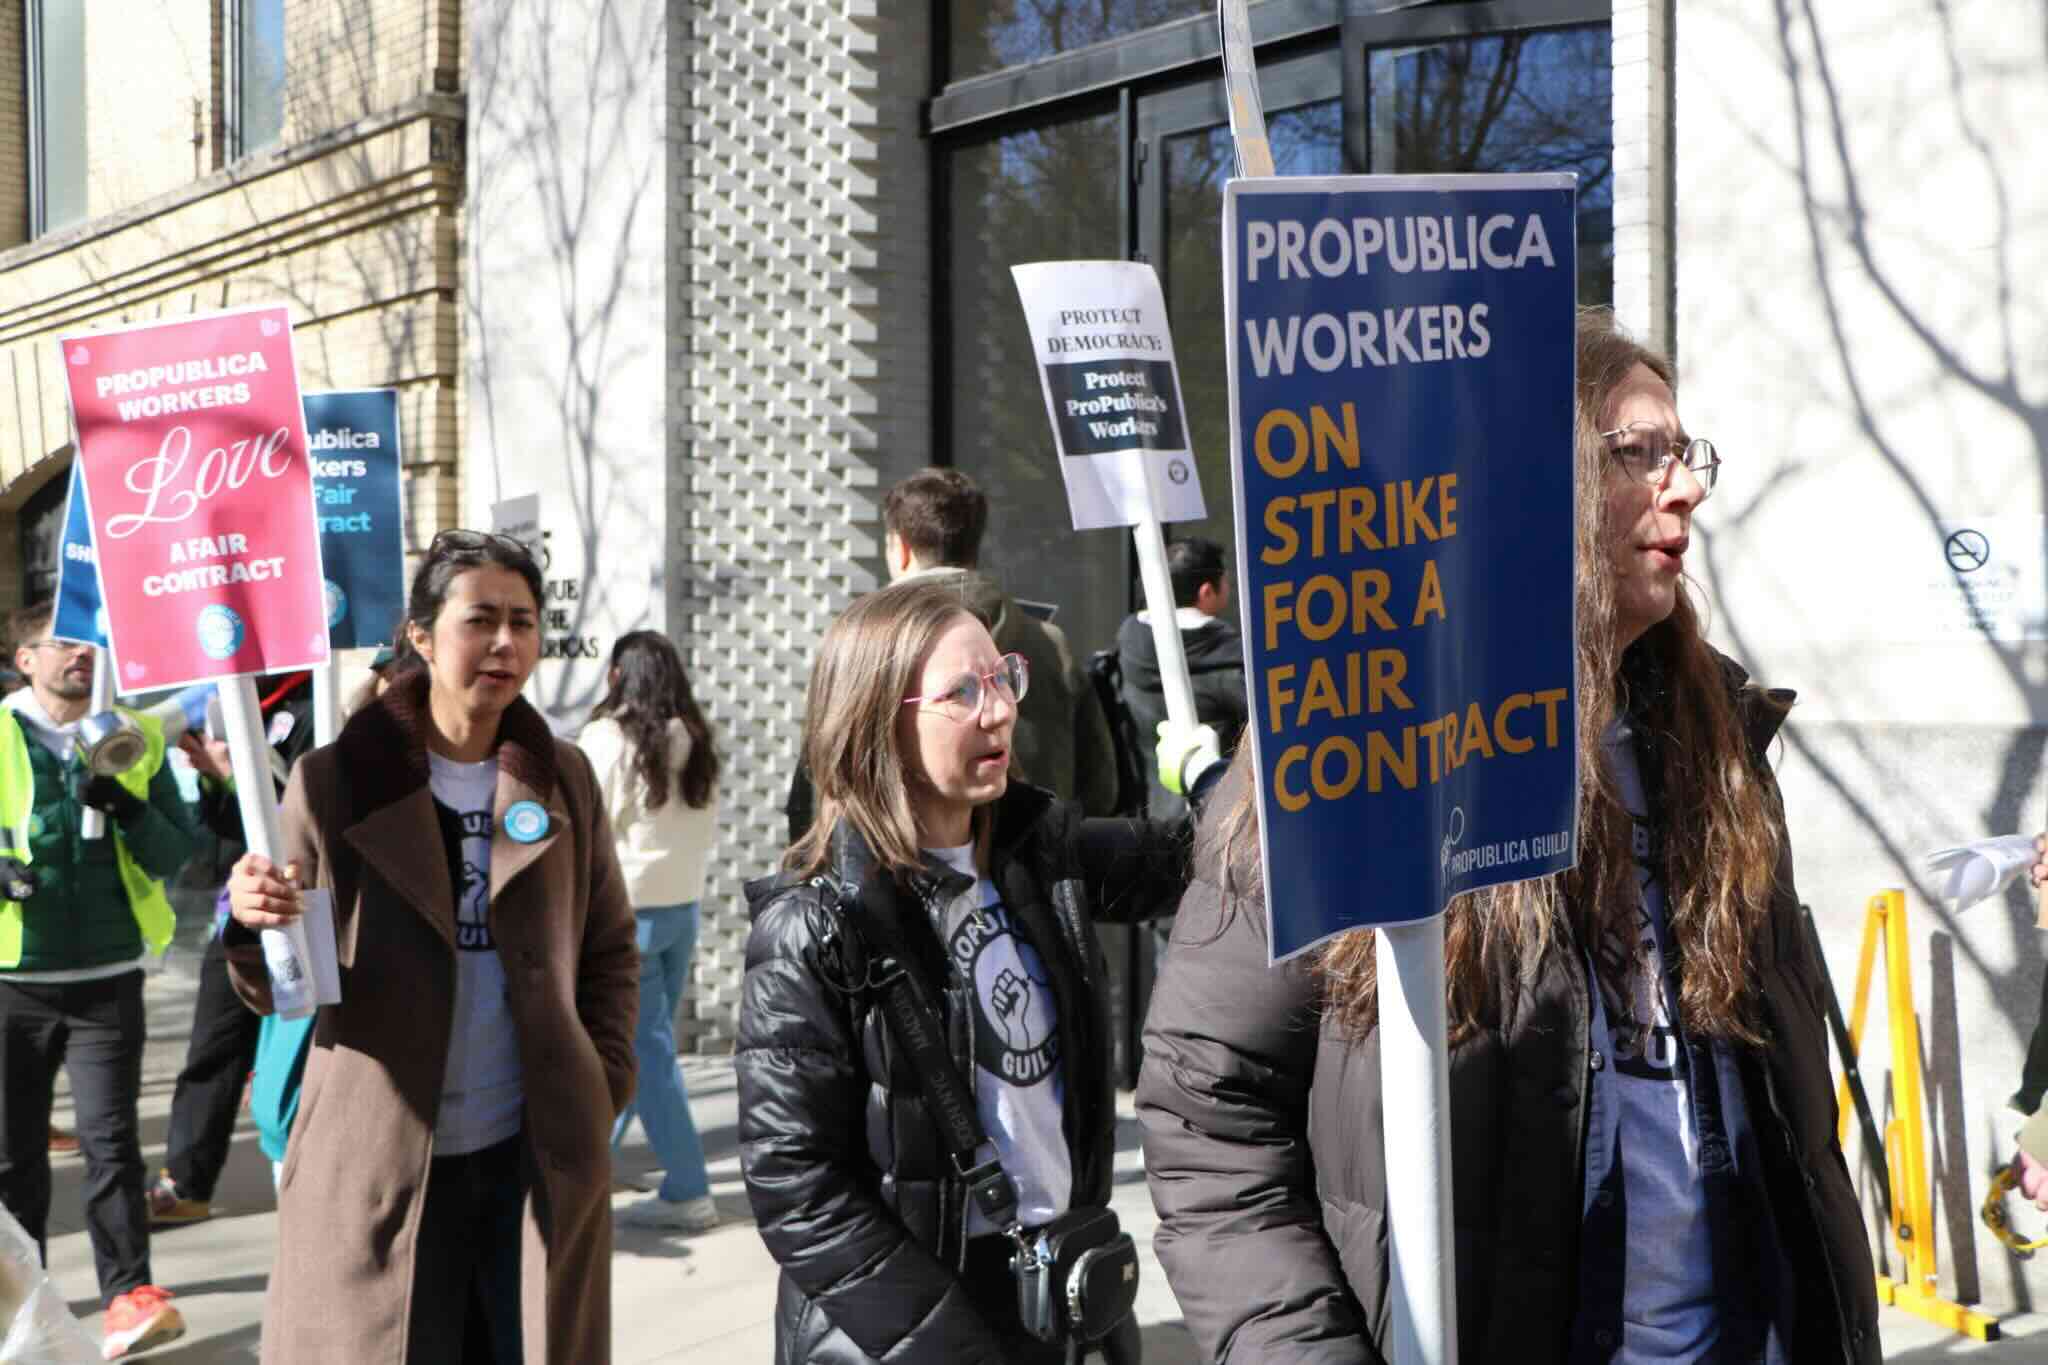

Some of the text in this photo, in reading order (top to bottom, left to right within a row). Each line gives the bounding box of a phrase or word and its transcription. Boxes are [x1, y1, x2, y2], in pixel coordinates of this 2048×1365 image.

[1247, 213, 1555, 282] PROPUBLICA
[1061, 308, 1142, 326] PROTECT
[1245, 303, 1491, 377] WORKERS
[96, 351, 269, 398] PROPUBLICA
[1083, 371, 1147, 390] Protect
[117, 382, 251, 421] WORKERS
[305, 427, 380, 450] ublica
[1253, 402, 1361, 479] ON
[105, 426, 293, 539] Love
[311, 456, 367, 477] kers
[319, 511, 373, 533] ract
[1260, 473, 1457, 566] STRIKE
[170, 532, 248, 564] A FAIR
[142, 557, 286, 597] CONTRACT
[1263, 559, 1448, 652] FOR A
[1266, 648, 1416, 735] FAIR
[1273, 687, 1568, 813] CONTRACT
[1532, 831, 1569, 860] GUILD
[1002, 1049, 1050, 1080] GUIL
